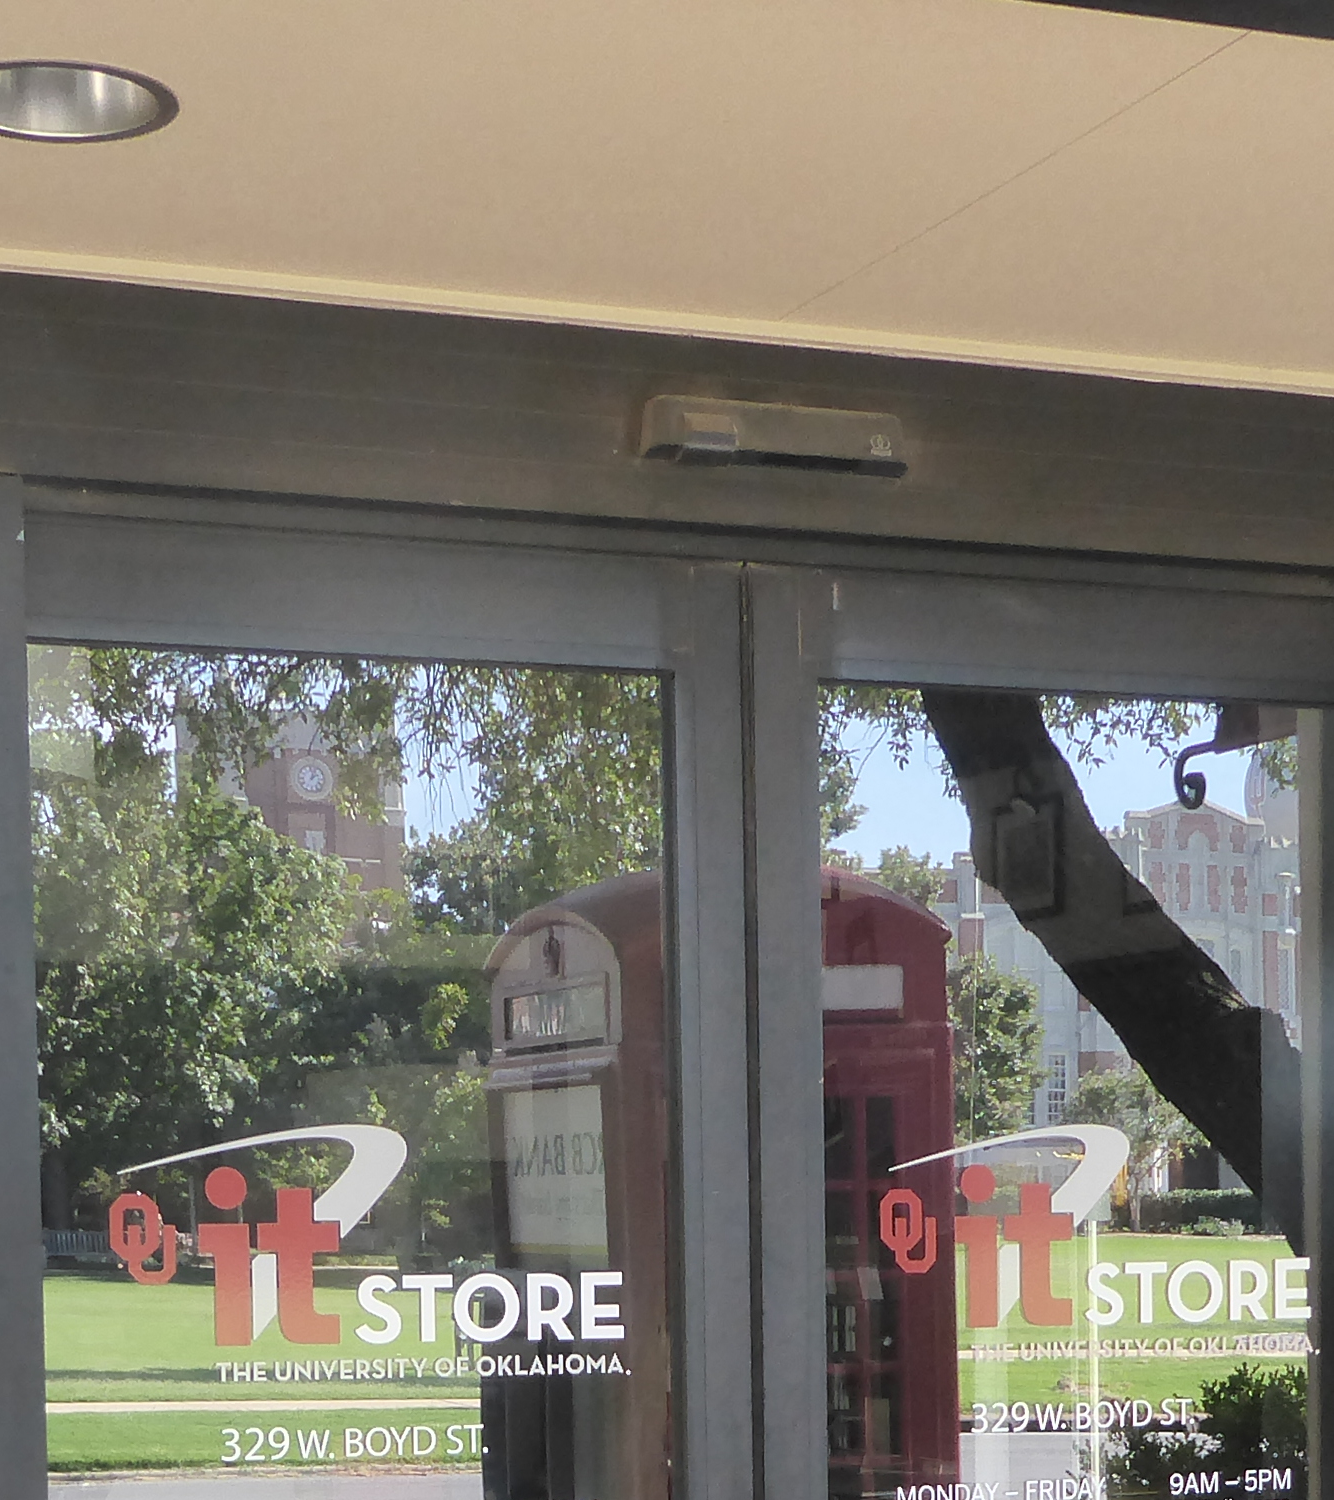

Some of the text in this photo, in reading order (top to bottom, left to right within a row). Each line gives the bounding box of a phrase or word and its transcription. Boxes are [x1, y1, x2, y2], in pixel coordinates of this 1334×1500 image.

[109, 1166, 626, 1346] OU it STORE
[879, 1164, 1312, 1327] OU it STORE
[971, 1343, 1014, 1362] THE
[1020, 1338, 1150, 1362] UNIVERSITY
[1154, 1337, 1184, 1357] OF
[216, 1353, 632, 1383] THE UNIVERSITY OF OKLAHOMA.
[971, 1398, 1195, 1433] 329 W. BOYD ST.
[221, 1424, 489, 1462] 329 W. BOYD ST.
[1170, 1472, 1219, 1495] 9AM
[1245, 1468, 1292, 1492] 5PM
